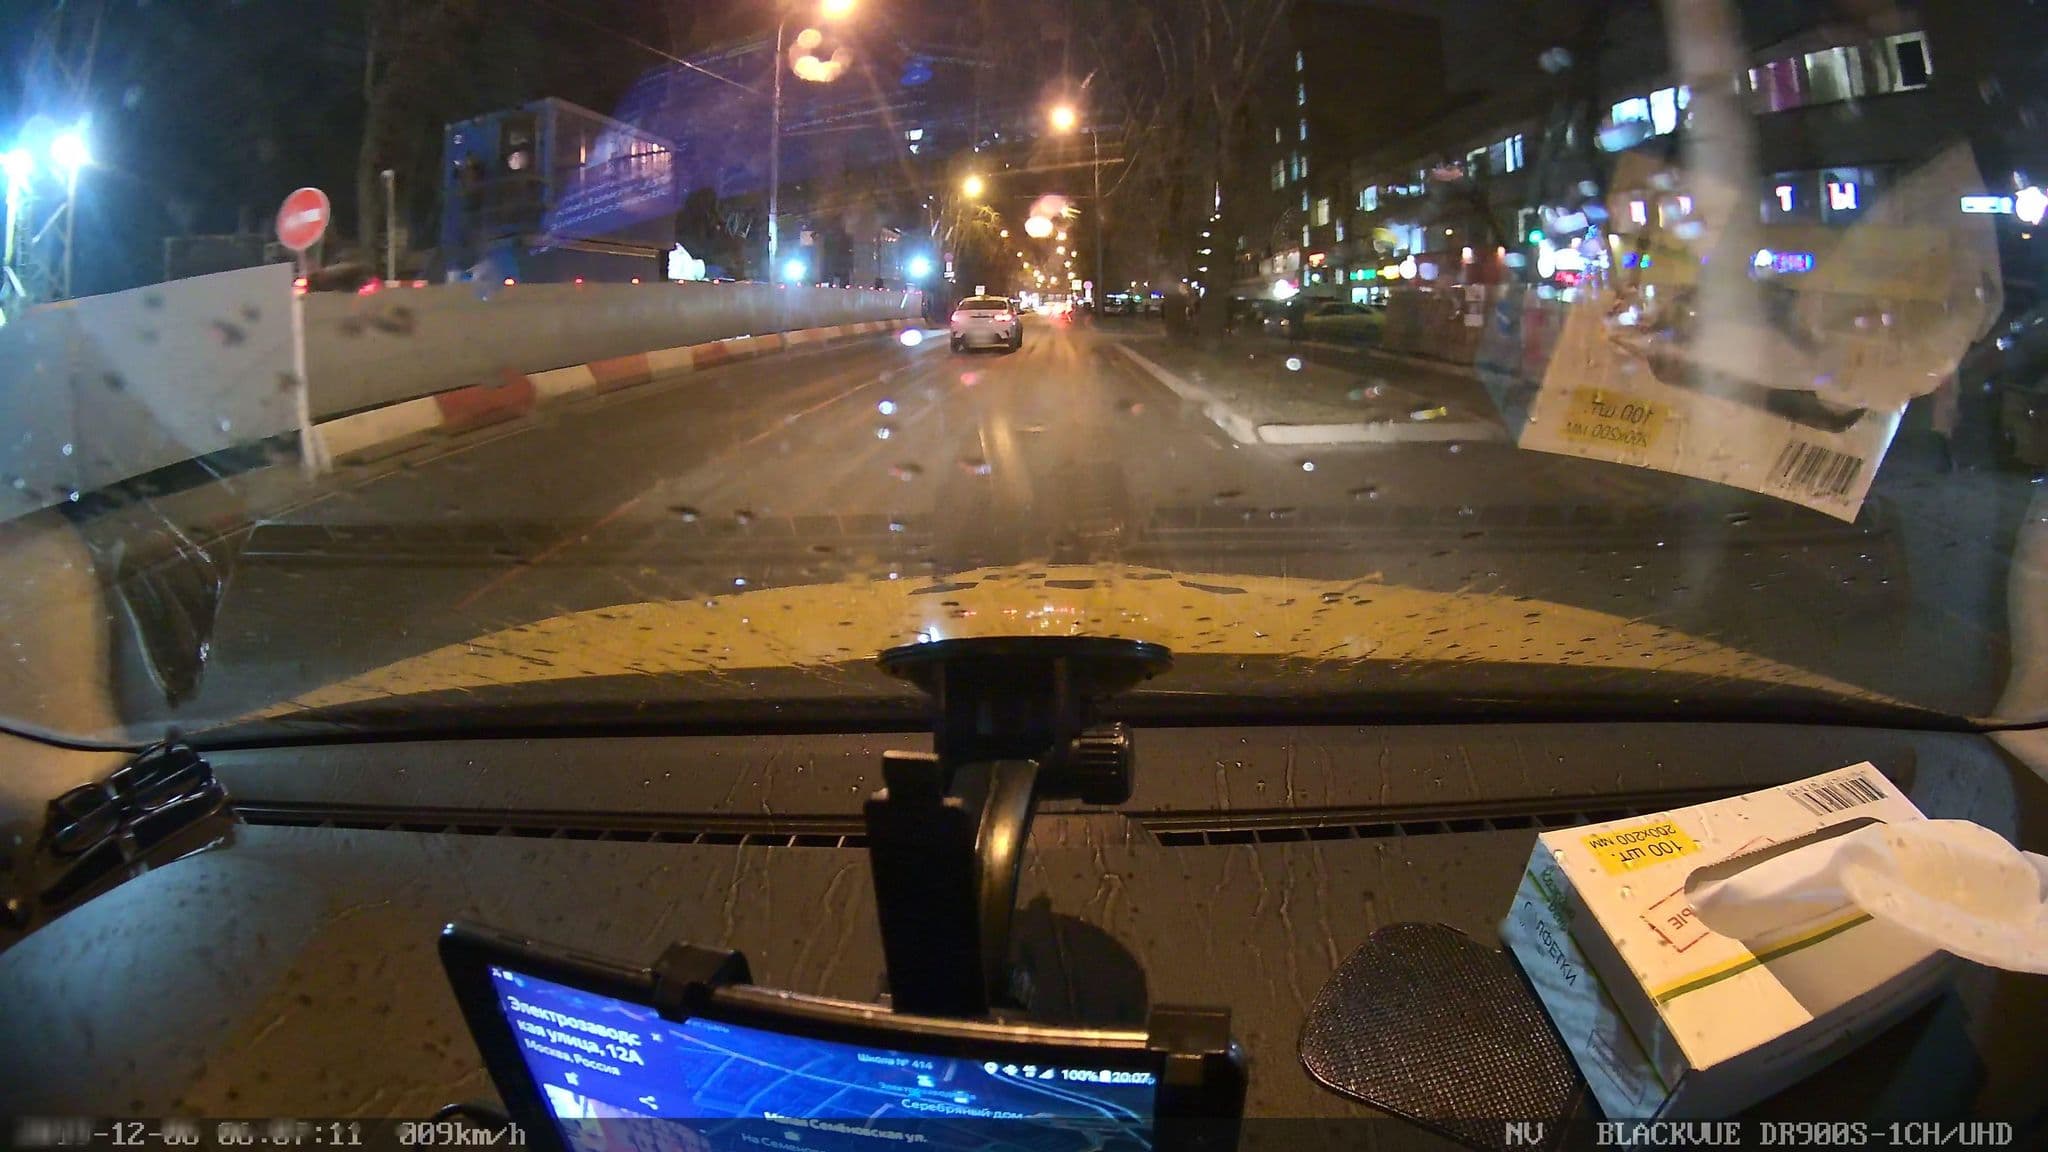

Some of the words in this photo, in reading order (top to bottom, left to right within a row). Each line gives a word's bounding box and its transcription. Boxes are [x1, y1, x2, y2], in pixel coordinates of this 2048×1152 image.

[1647, 839, 1683, 857] 100
[507, 995, 643, 1047] Электрозаводс
[516, 1019, 547, 1037] кая
[573, 1053, 621, 1076] Россия
[1061, 1069, 1099, 1082] 100%
[1111, 1072, 1151, 1084] 20:07
[901, 1098, 991, 1118] Серебряный
[992, 1110, 1024, 1119] дом
